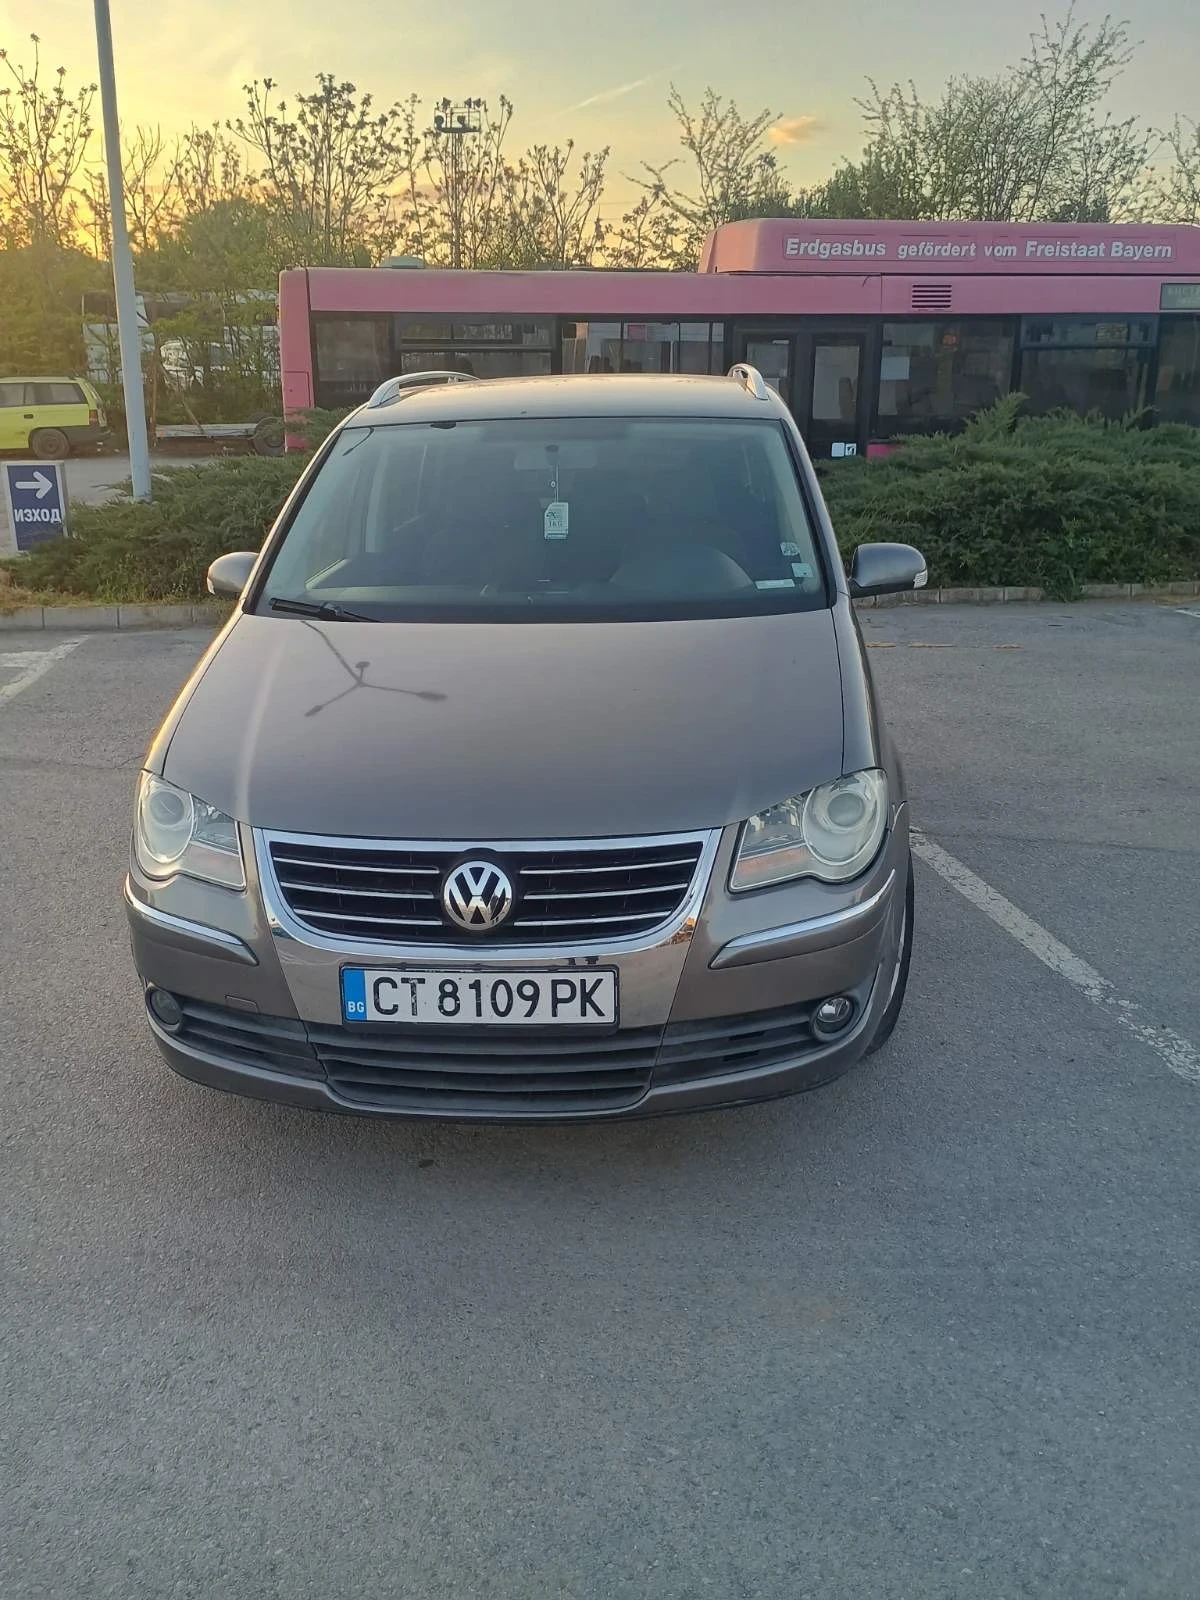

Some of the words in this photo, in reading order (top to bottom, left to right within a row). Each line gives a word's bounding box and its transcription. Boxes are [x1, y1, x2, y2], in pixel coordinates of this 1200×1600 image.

[786, 238, 886, 258] Erdgasbus
[898, 242, 976, 258] gefördert
[984, 245, 1017, 257] vom
[1025, 241, 1105, 257] Freistaat
[1110, 241, 1172, 260] Bayern
[14, 508, 62, 524] ИЗХОД
[347, 1001, 365, 1013] BG
[438, 979, 540, 1018] 8109
